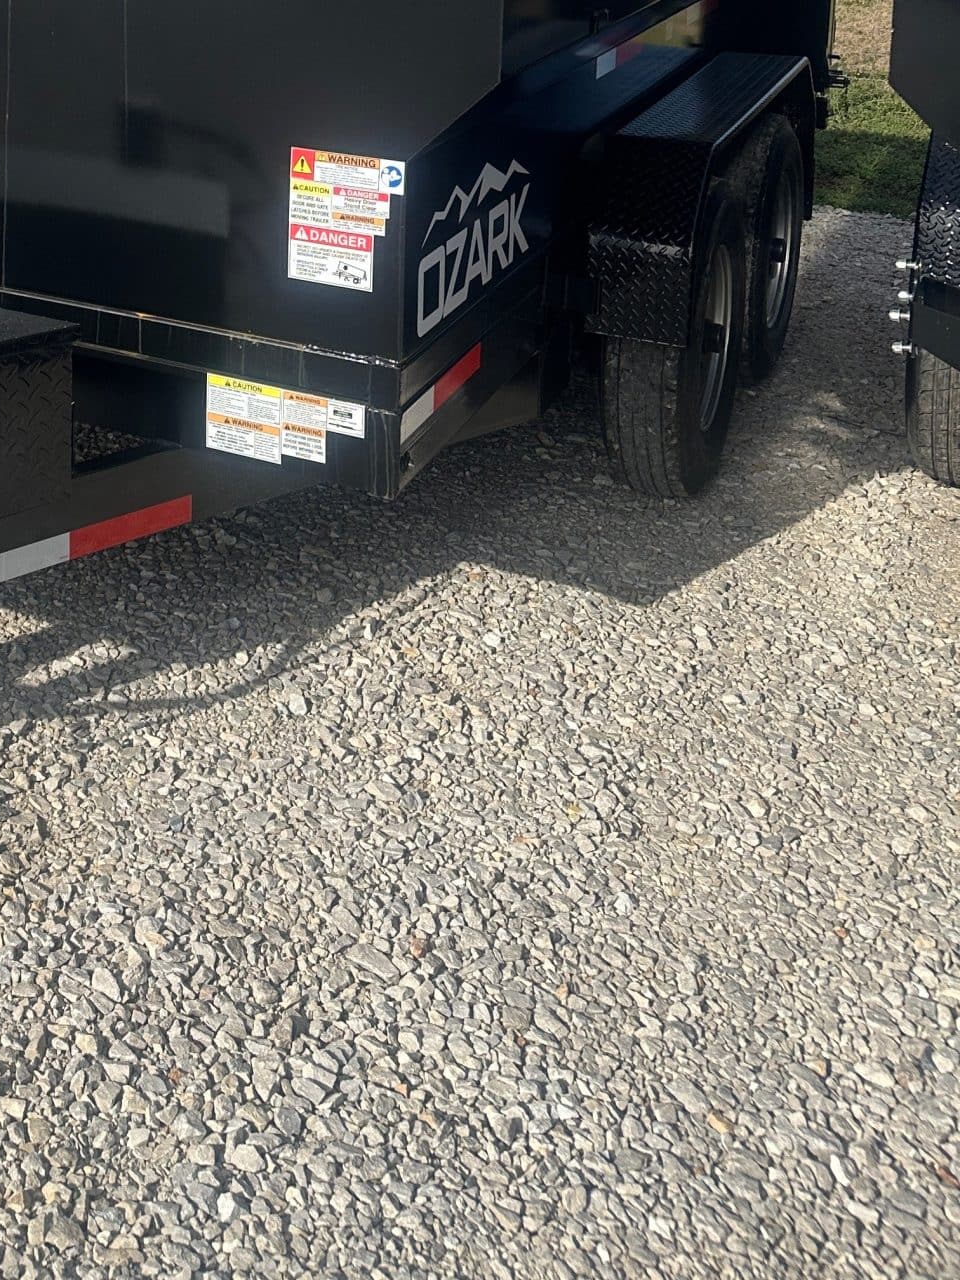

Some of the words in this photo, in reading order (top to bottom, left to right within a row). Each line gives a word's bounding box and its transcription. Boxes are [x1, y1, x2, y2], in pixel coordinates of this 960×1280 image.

[327, 154, 377, 168] WARNING
[299, 185, 330, 194] CAUTION
[347, 190, 379, 200] DANGER
[344, 214, 375, 224] WARNING
[309, 230, 367, 249] DANGER
[417, 183, 530, 337] OZARK
[232, 381, 263, 393] CAUTION
[295, 395, 321, 405] WARNING
[231, 418, 264, 432] WARNING
[291, 425, 322, 436] WARNING
